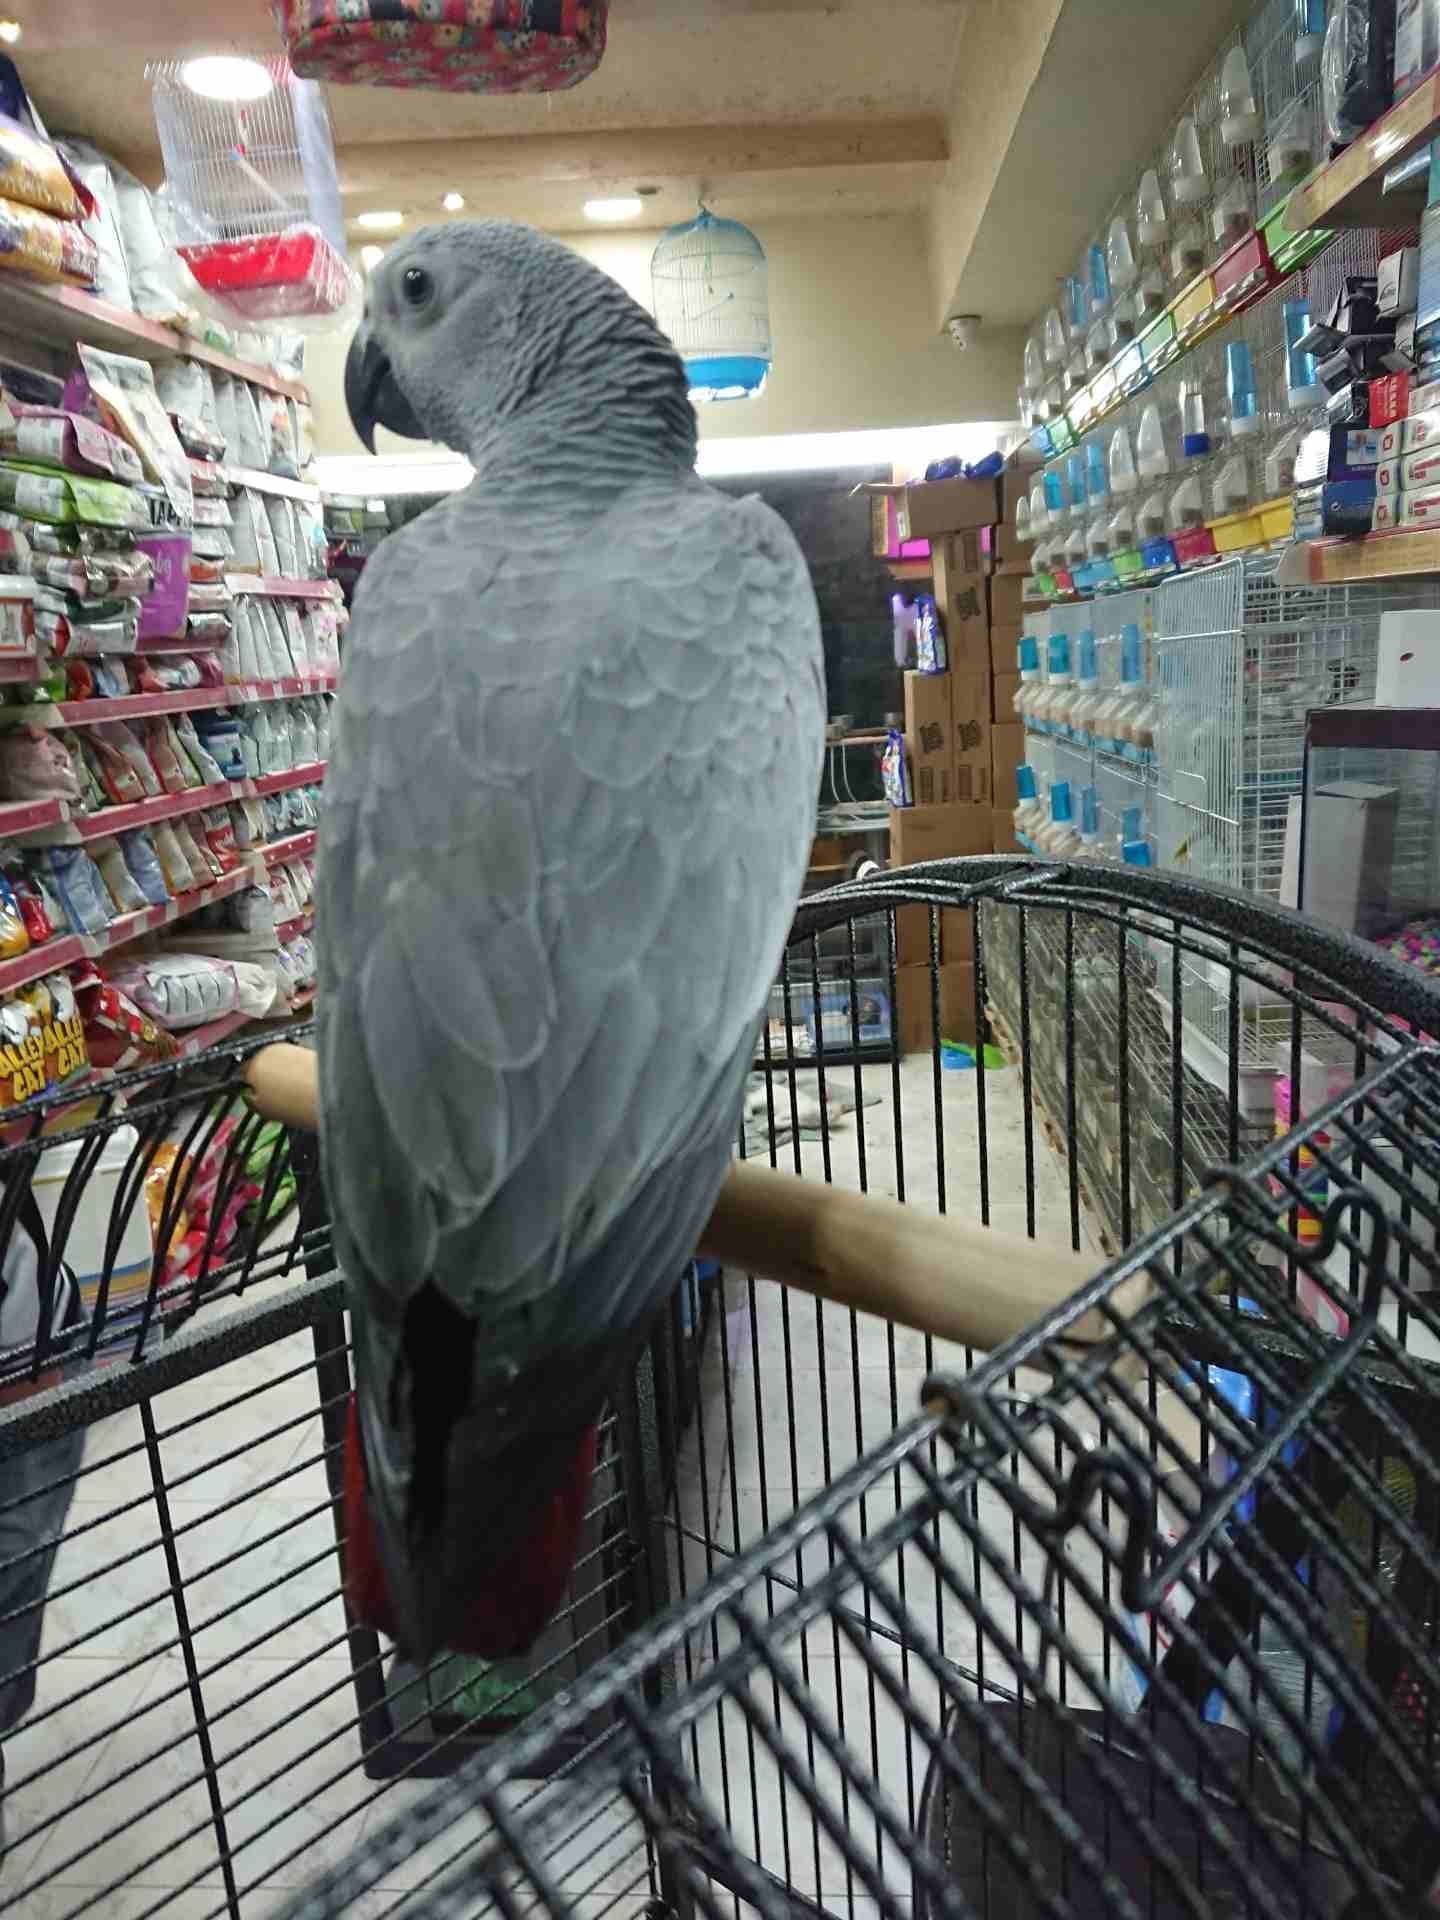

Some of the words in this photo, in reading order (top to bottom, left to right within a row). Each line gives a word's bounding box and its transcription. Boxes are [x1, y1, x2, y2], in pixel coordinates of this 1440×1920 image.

[0, 1035, 45, 1078] ALLEY
[58, 1037, 85, 1077] CAT
[13, 1061, 46, 1101] CAT
